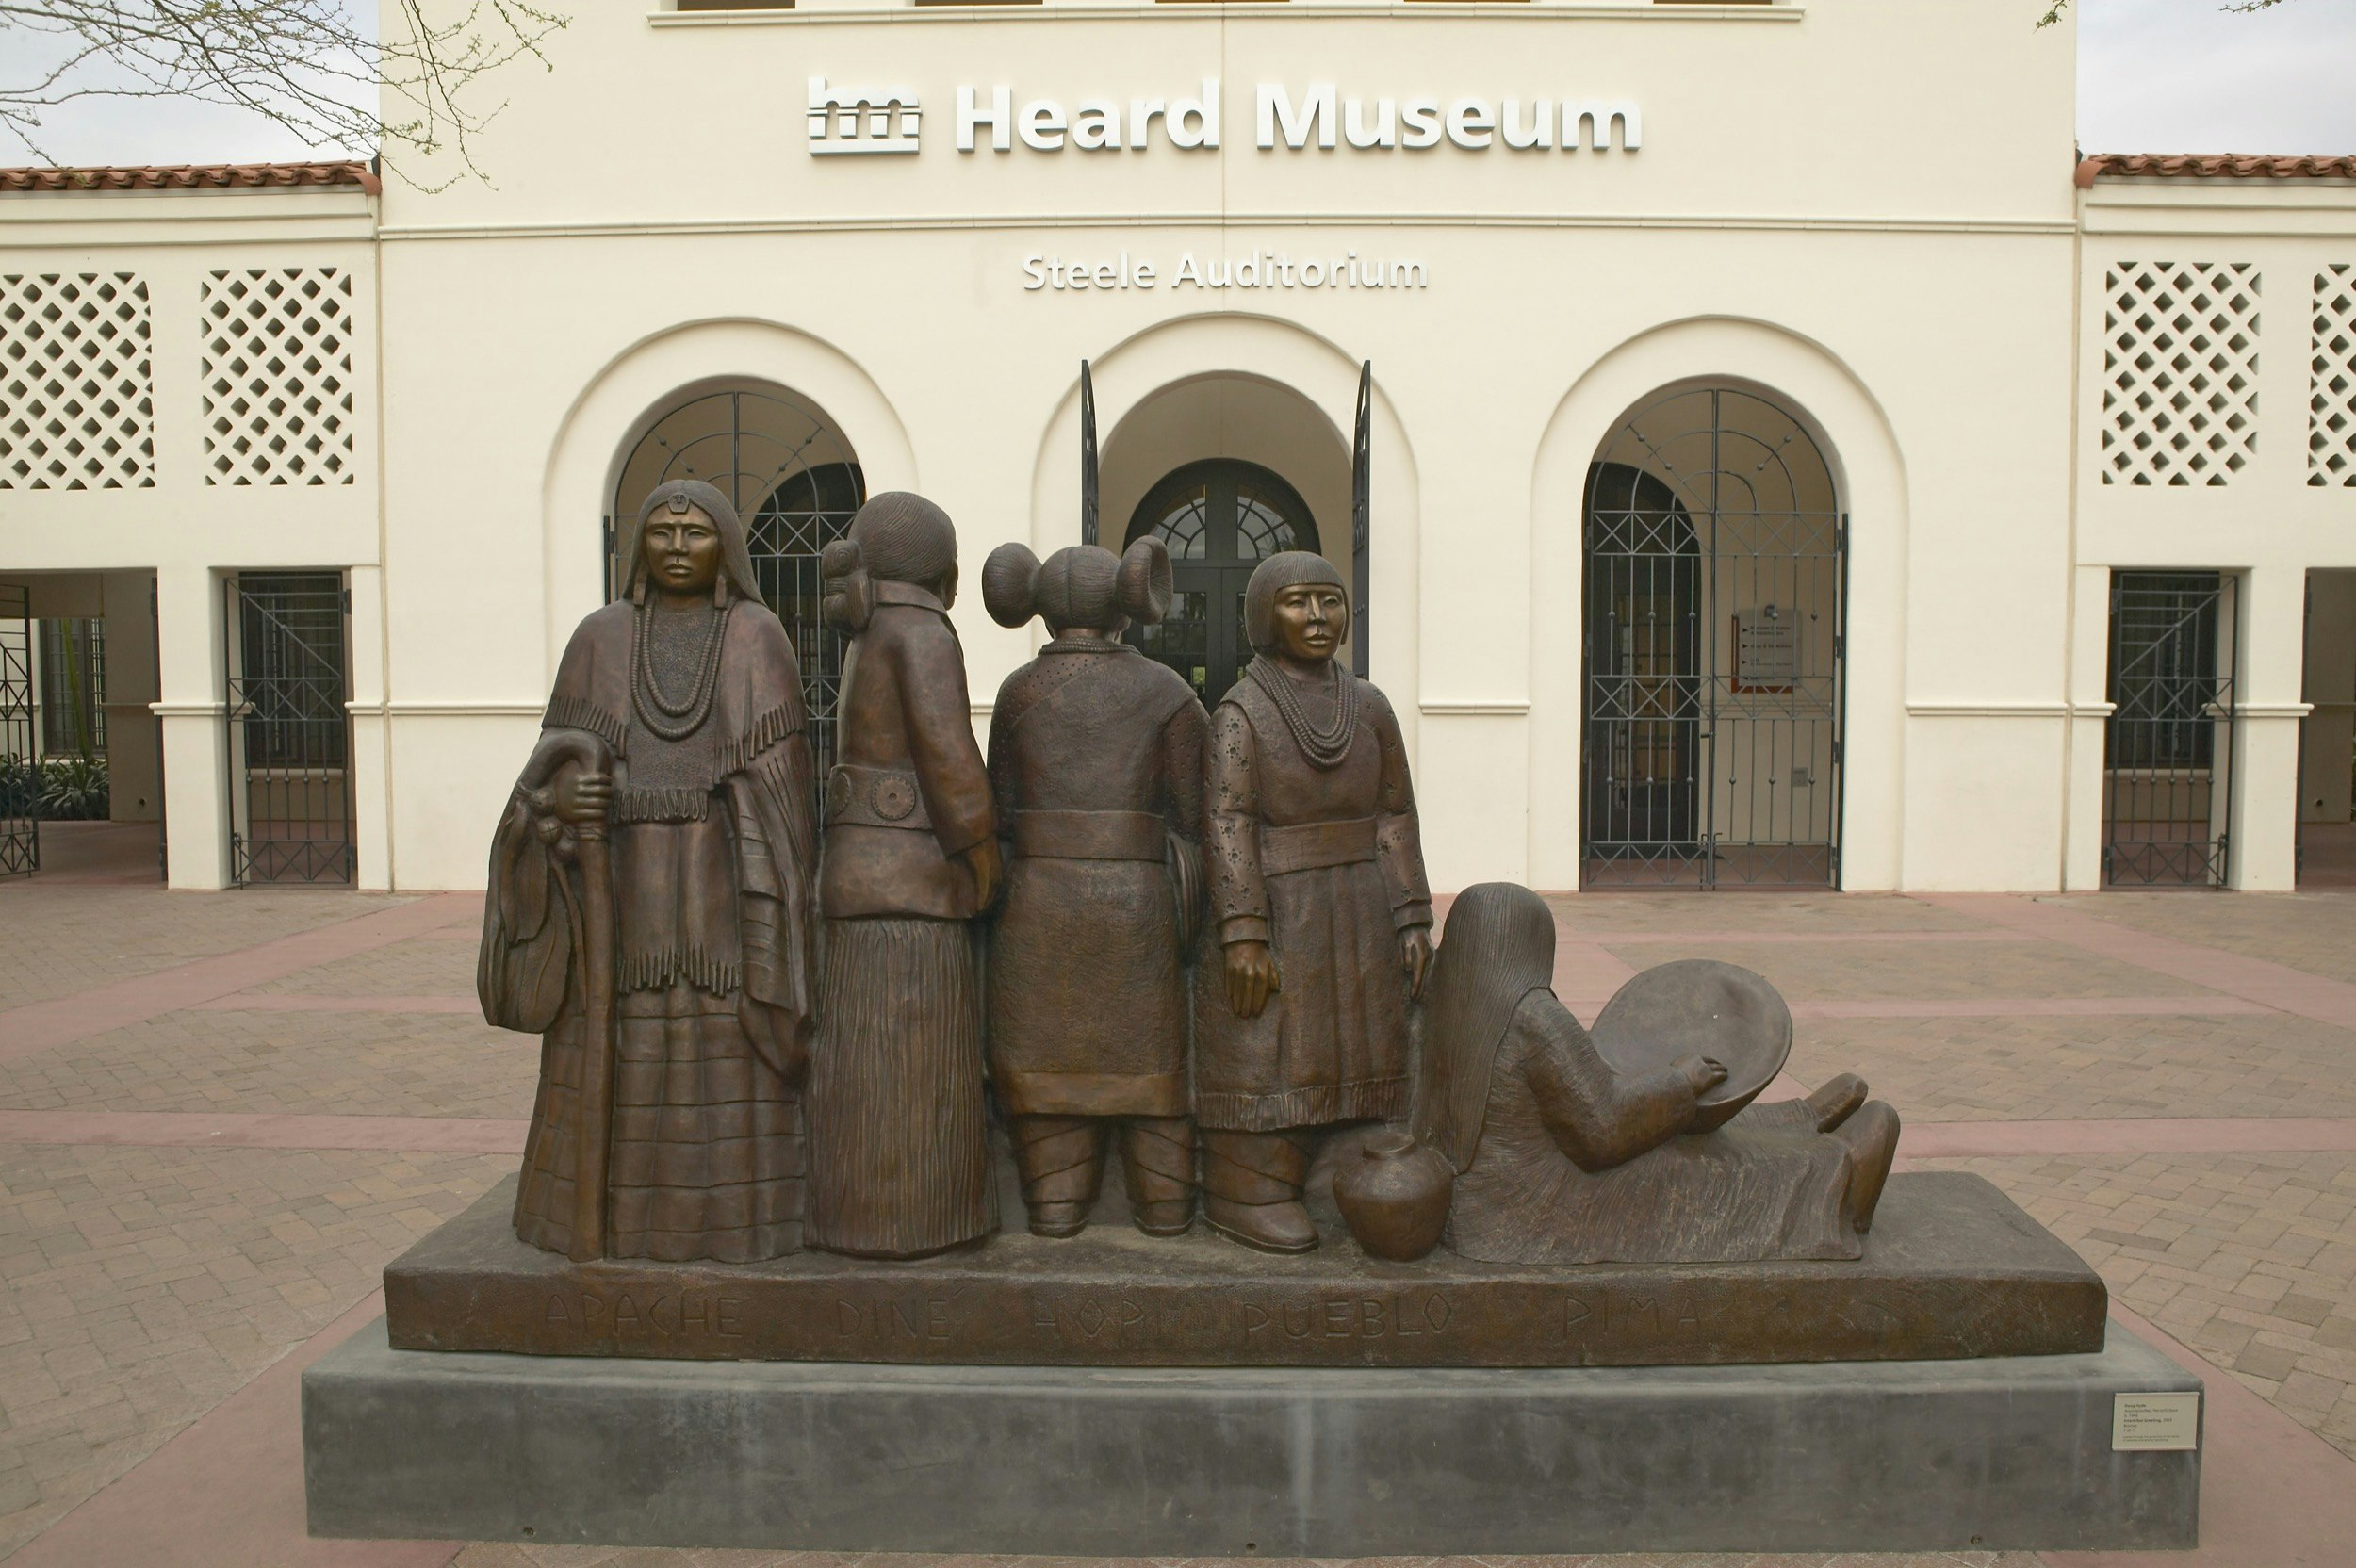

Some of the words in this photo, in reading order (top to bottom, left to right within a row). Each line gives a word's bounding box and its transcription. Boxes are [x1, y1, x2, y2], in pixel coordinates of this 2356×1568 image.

[957, 77, 1220, 153] Heard
[1256, 82, 1642, 152] Museum
[1022, 250, 1157, 290] Steele
[1171, 250, 1429, 289] Auditorium
[546, 1293, 744, 1338] APACHE
[1030, 1295, 1162, 1339] HOPI
[1243, 1292, 1451, 1341] PUEBLO
[1562, 1294, 1701, 1338] PIMA
